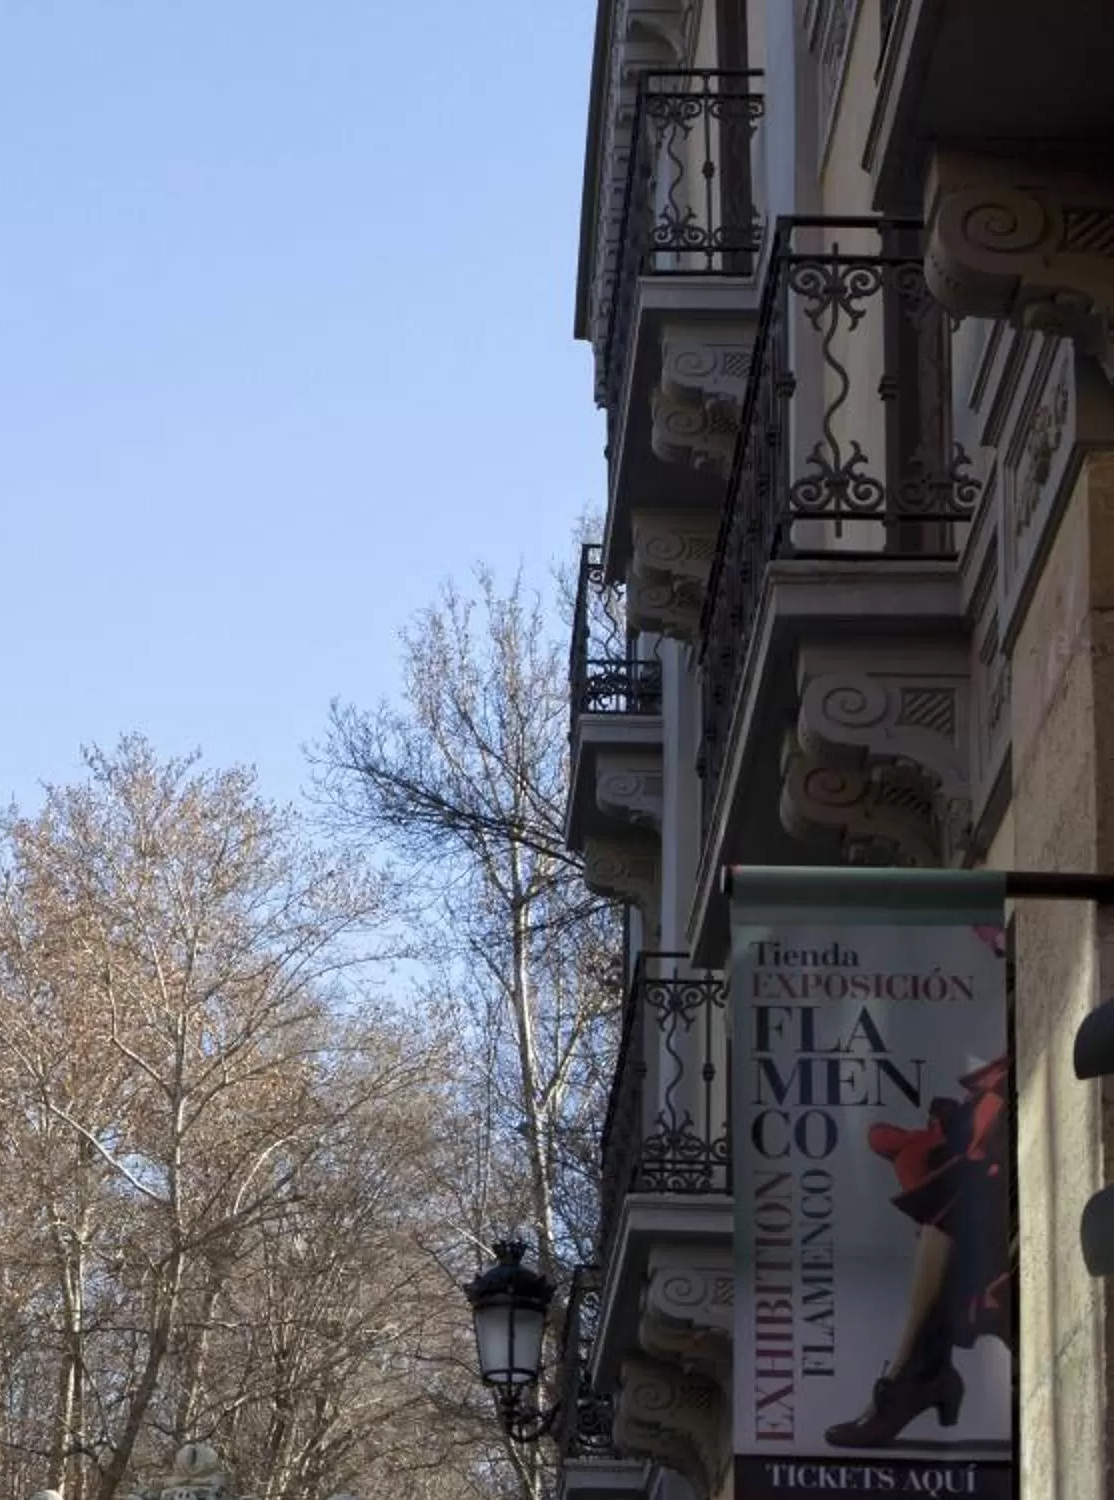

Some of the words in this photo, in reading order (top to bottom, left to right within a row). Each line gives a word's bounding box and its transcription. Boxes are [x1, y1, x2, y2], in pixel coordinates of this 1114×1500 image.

[750, 941, 860, 967] Tienda
[751, 967, 975, 1001] EXPOSICIÓN
[751, 1004, 890, 1053] FLA
[751, 1057, 926, 1108] MEN
[751, 1108, 839, 1160] CO
[800, 1168, 835, 1378] FLAMENCO
[753, 1169, 795, 1443] EXHIBITION
[764, 1463, 895, 1489] TICKETS
[900, 1463, 979, 1496] AQUÍ
